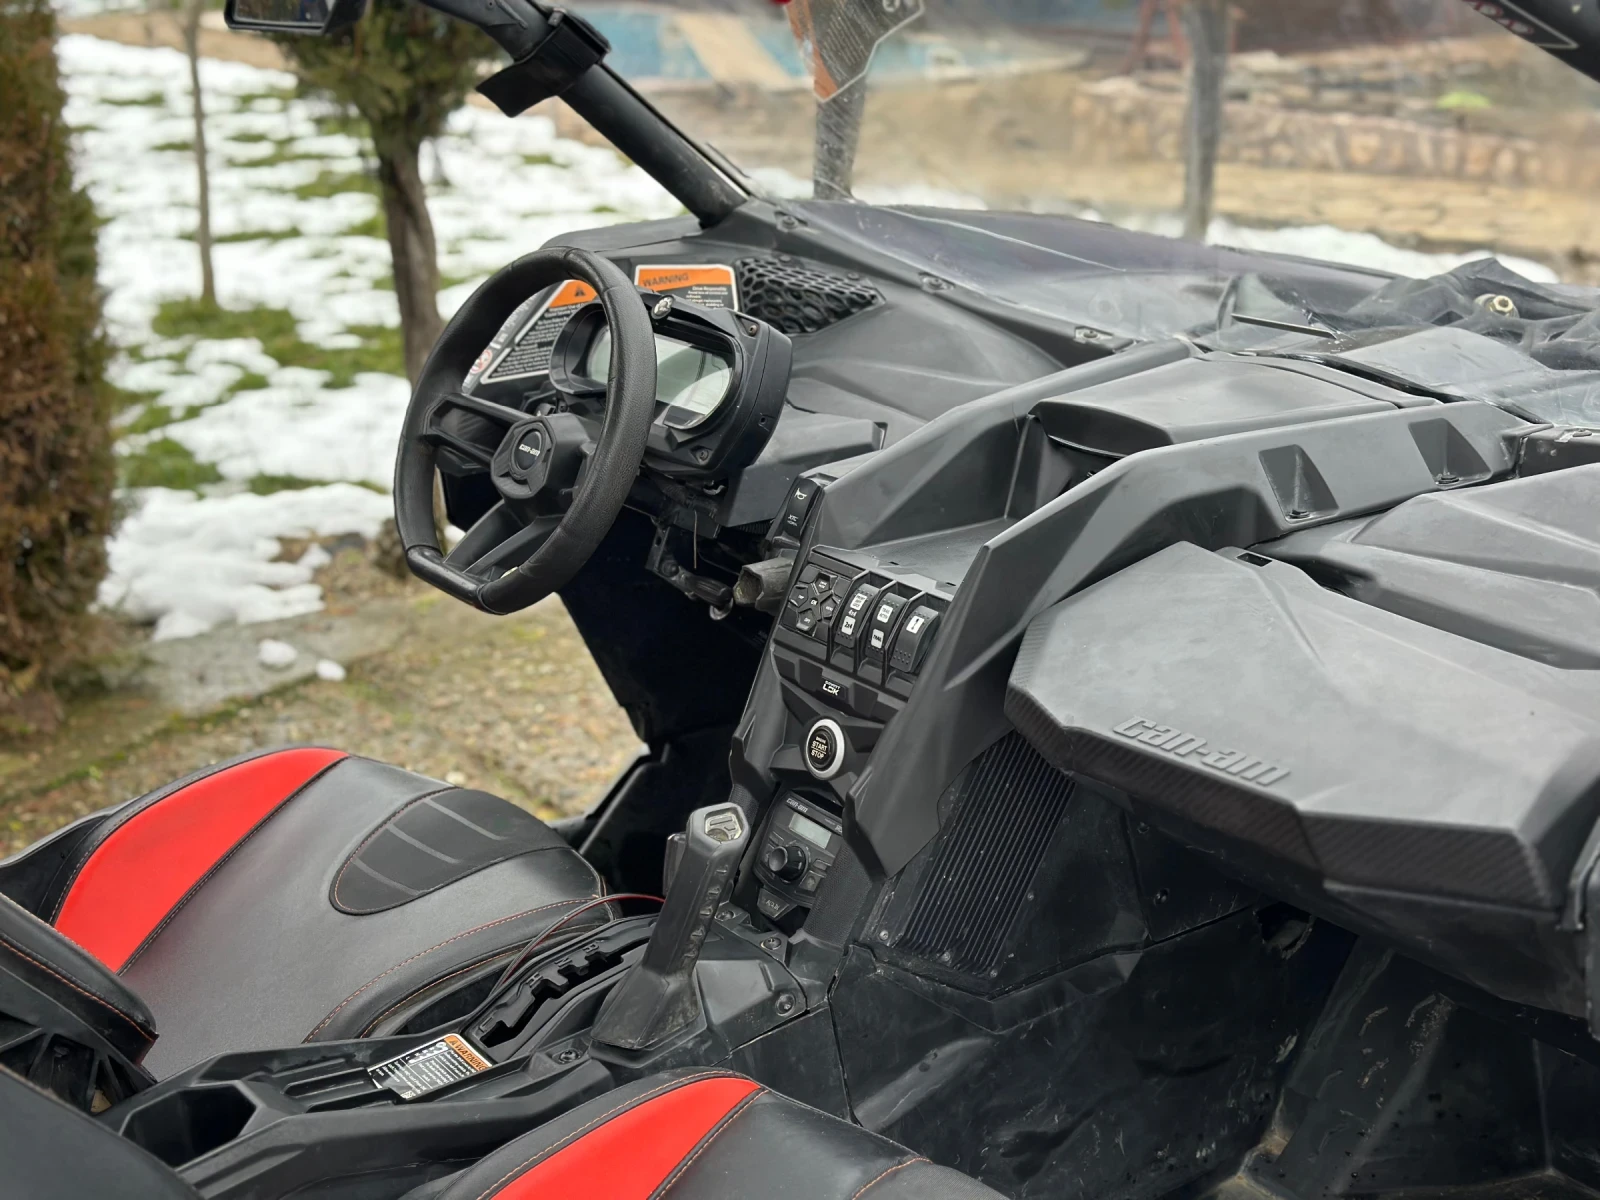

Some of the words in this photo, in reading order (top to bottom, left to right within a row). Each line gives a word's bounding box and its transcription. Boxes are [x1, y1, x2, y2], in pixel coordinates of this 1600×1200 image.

[643, 273, 690, 287] WARNING
[844, 621, 853, 630] 2x4
[812, 740, 828, 751] START
[1112, 716, 1292, 787] can-am
[811, 750, 824, 760] STOP
[455, 1043, 487, 1071] WARNING
